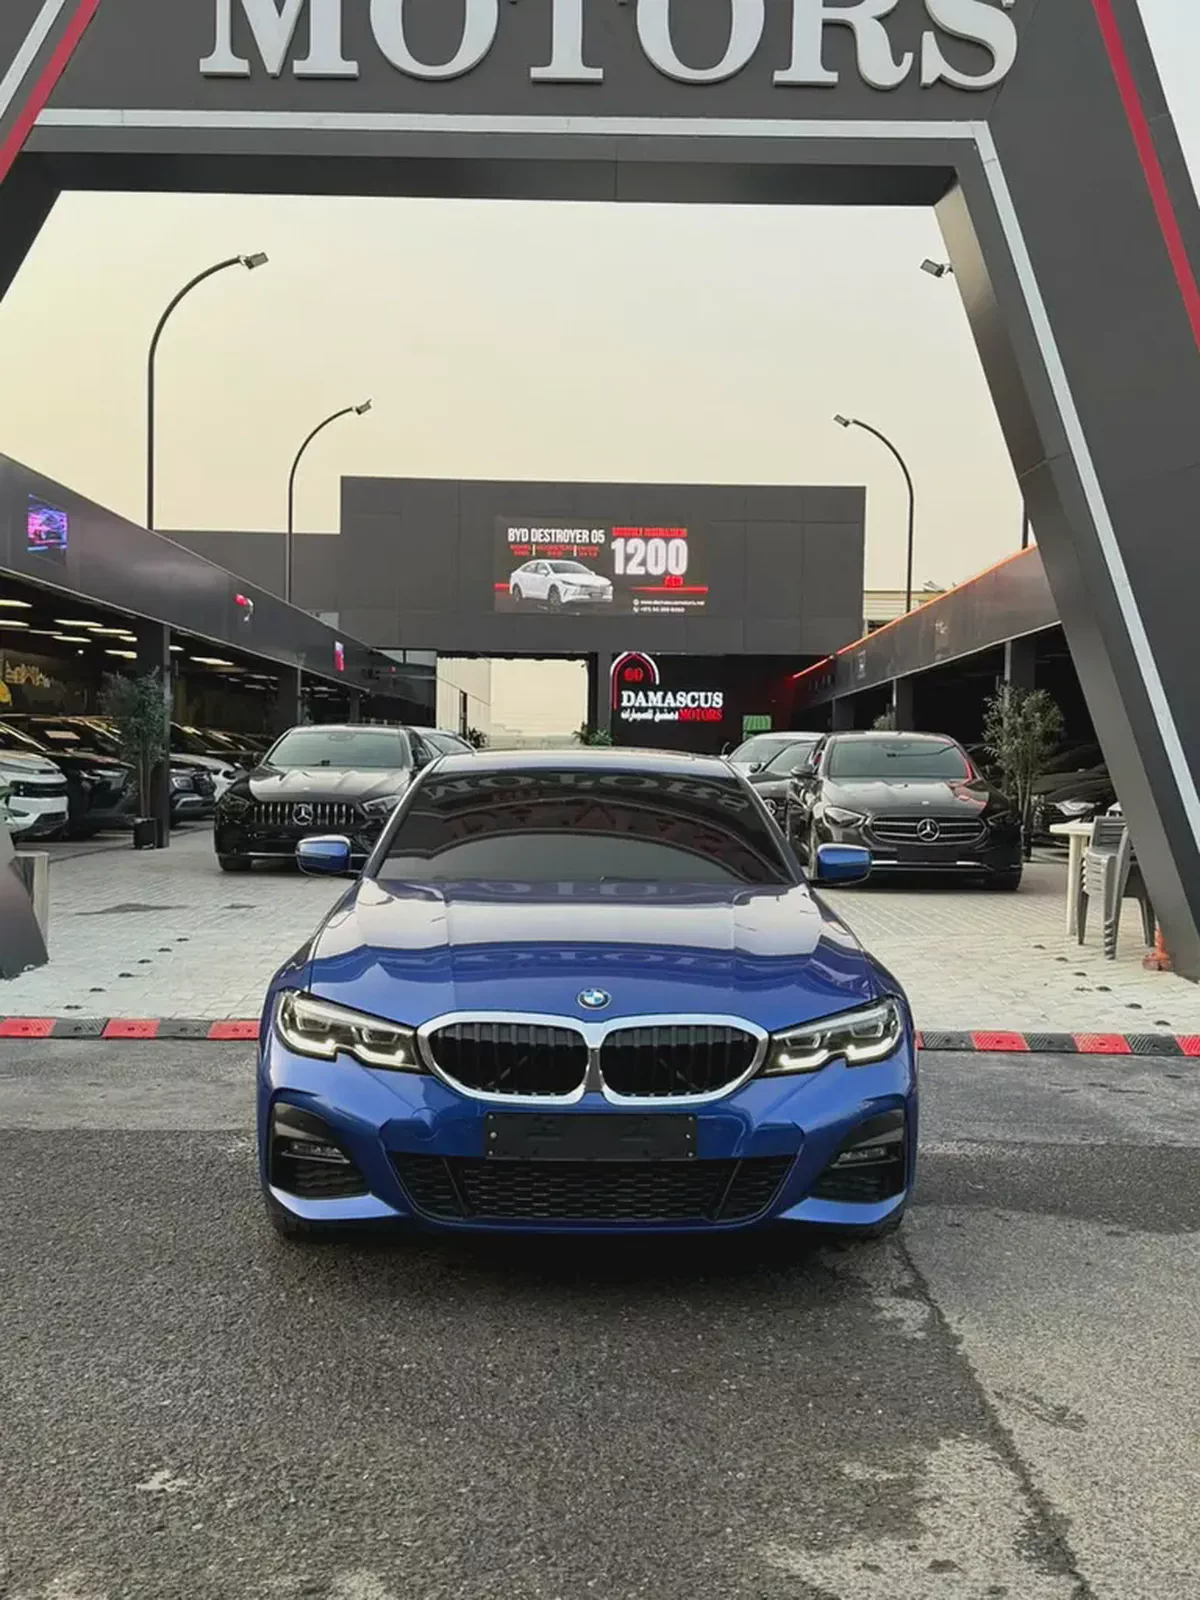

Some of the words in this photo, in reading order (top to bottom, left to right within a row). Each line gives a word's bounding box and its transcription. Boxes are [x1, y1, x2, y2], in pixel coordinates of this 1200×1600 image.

[199, 0, 1018, 91] MOTORS
[508, 528, 528, 542] BYD
[531, 528, 589, 543] DESTROYER
[591, 529, 605, 544] 05
[611, 538, 688, 575] 1200
[621, 691, 723, 708] DAMASCUS
[680, 708, 722, 721] MOTORS
